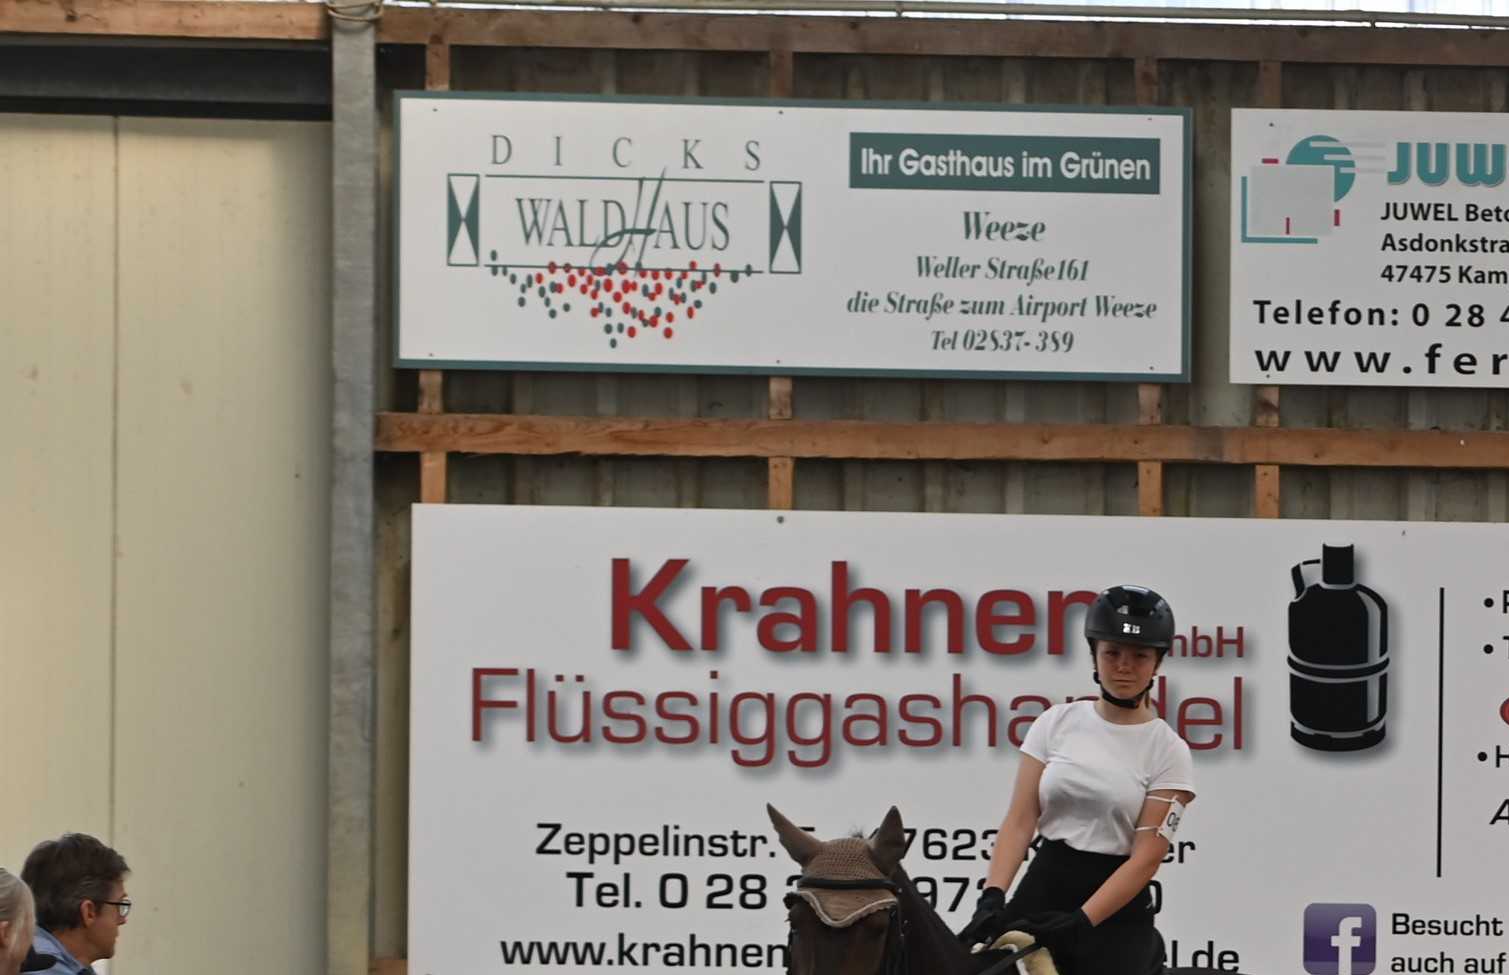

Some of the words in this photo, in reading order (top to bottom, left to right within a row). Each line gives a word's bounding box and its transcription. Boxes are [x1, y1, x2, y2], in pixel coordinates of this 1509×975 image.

[862, 148, 892, 174] Ihr
[899, 148, 1014, 177] Gasthaus
[1022, 151, 1052, 177] im
[1060, 152, 1150, 179] Grünen
[1381, 203, 1458, 221] JUWEL
[964, 212, 1045, 241] Weeze
[917, 256, 981, 278] Weller
[1381, 265, 1451, 283] 47475
[847, 291, 879, 312] die
[884, 292, 954, 320] Straße
[960, 300, 1004, 315] zum
[1011, 295, 1087, 323] Airport
[1096, 296, 1157, 318] Weeze
[1253, 300, 1398, 326] Telefon:
[1413, 303, 1429, 326] 0
[1446, 304, 1484, 327] 28
[933, 331, 958, 350] Tel
[1035, 331, 1074, 352] 389
[471, 667, 1242, 768] Flüssiggashael
[535, 822, 777, 864] Zeppelinstr.
[567, 873, 641, 909] Tel.
[659, 874, 688, 909] 0
[705, 874, 767, 911] 28
[1392, 913, 1503, 936] Besucht
[1391, 952, 1454, 973] auch
[1464, 952, 1506, 974] auf
